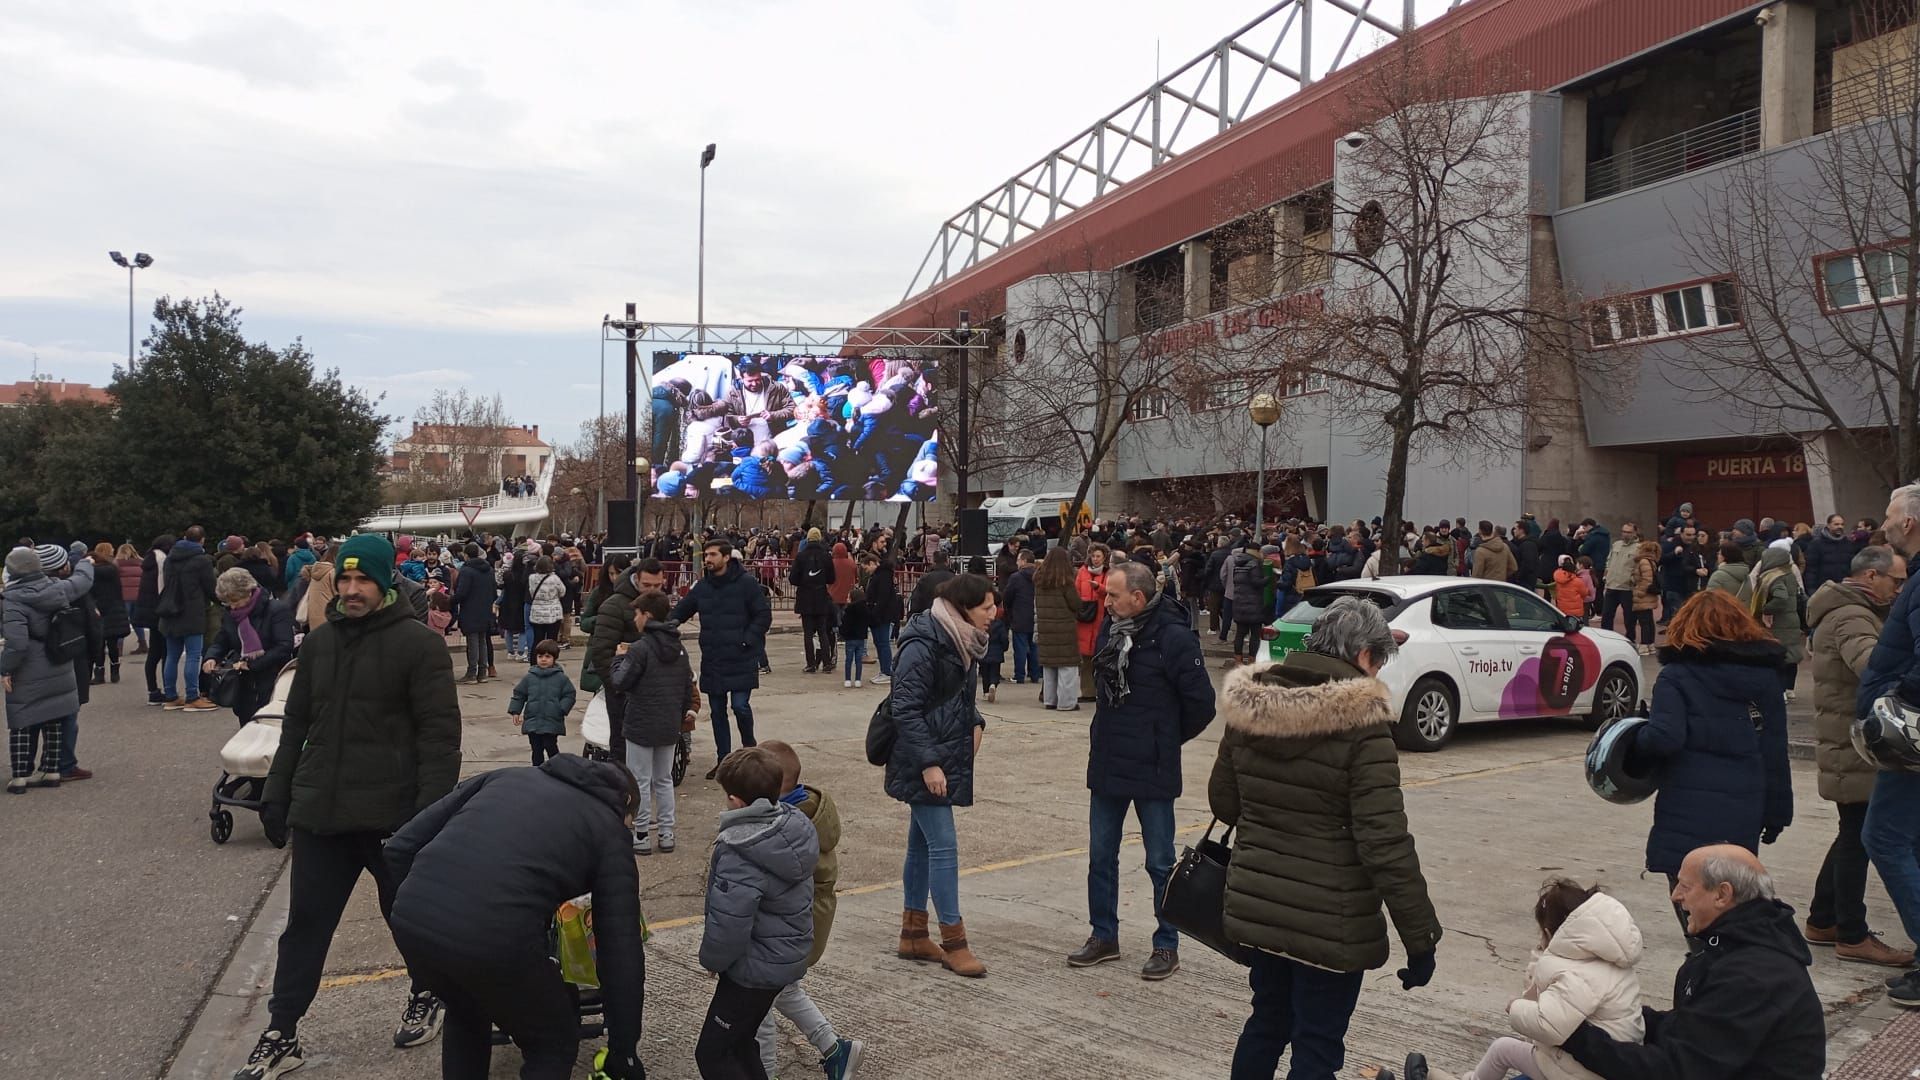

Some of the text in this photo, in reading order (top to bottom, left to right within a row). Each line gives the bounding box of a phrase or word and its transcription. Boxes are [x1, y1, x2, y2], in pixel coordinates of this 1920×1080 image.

[1708, 455, 1803, 476] PUERTA 18
[1469, 659, 1513, 676] 7rioja.tv
